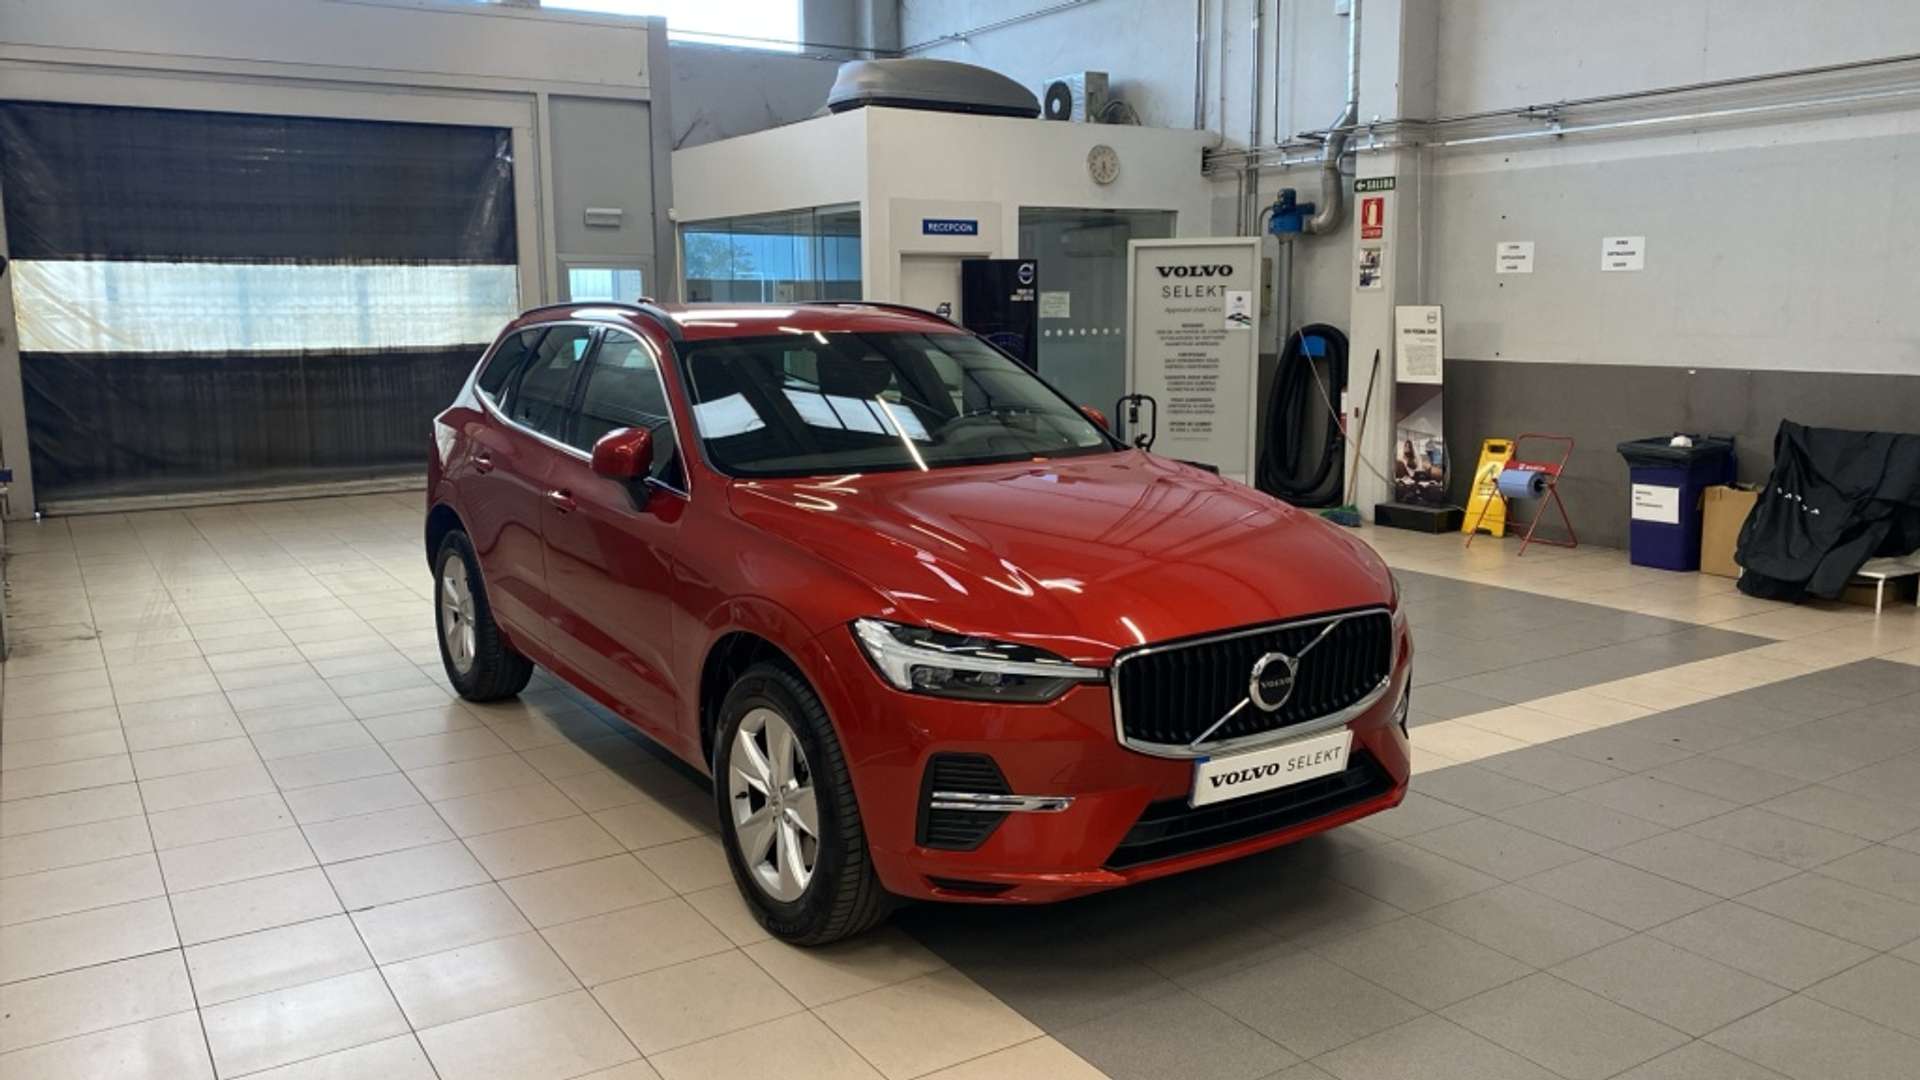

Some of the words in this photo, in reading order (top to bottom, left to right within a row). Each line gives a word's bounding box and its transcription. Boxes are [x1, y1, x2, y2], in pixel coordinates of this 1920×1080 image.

[1367, 179, 1393, 190] SALIDA
[1155, 265, 1233, 278] VOLVO
[1162, 285, 1227, 298] SELEKT
[1261, 677, 1292, 688] VOLVO
[1209, 763, 1280, 788] VOLVO
[1287, 746, 1342, 772] SELEKT
